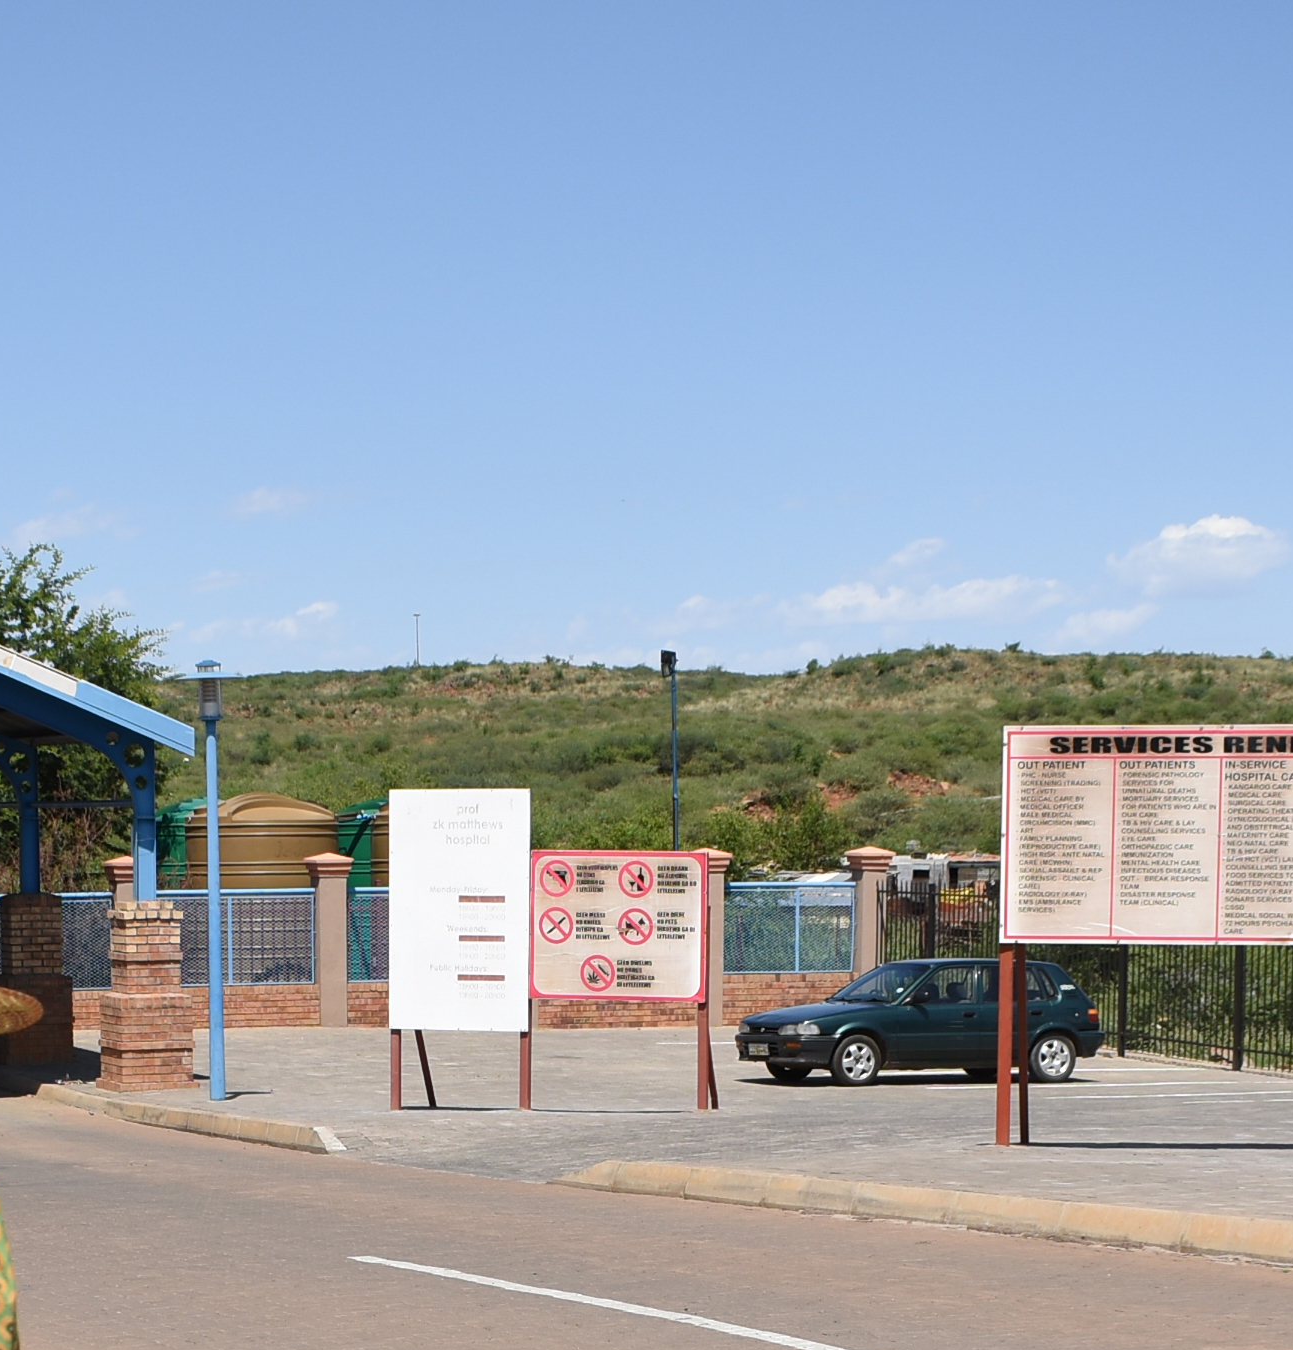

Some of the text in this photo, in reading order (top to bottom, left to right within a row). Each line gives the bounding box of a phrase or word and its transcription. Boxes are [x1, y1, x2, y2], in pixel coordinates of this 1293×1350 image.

[1049, 736, 1213, 753] SERVICES
[1018, 761, 1086, 770] OUT PATIENT
[1119, 761, 1196, 769] OUT PATIENTS
[1225, 761, 1287, 769] IN-SERVICE
[1225, 773, 1278, 781] HOSPITAL
[456, 804, 479, 816] prof
[448, 819, 503, 830] matthews
[445, 835, 490, 846] hospital
